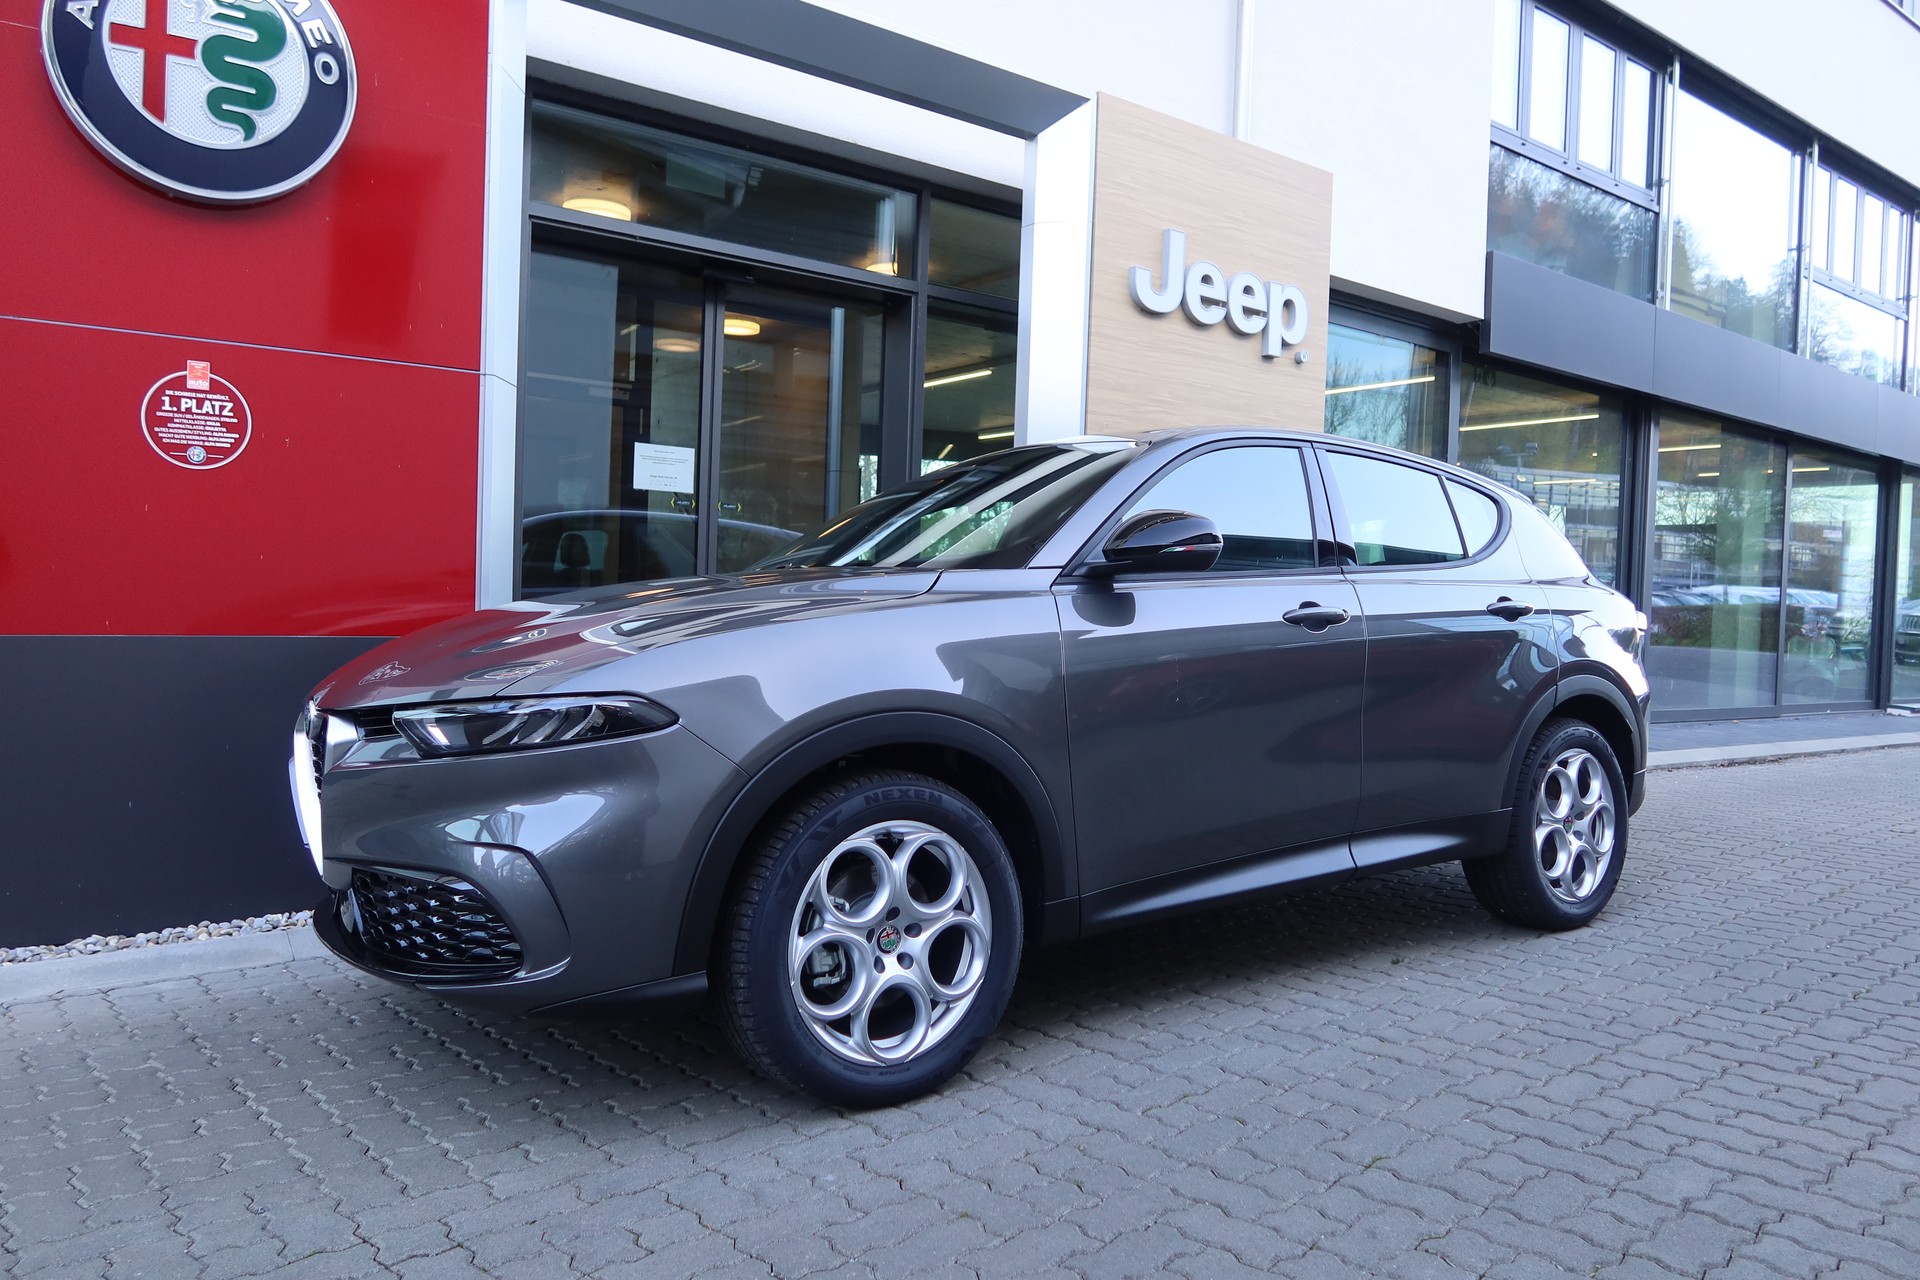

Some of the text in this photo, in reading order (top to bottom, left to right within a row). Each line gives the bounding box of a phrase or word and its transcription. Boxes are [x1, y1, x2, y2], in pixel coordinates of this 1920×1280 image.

[284, 0, 340, 85] MEO
[1128, 228, 1309, 359] Jeep
[161, 396, 234, 416] 1. PLATZ
[863, 788, 943, 807] NEXEN
